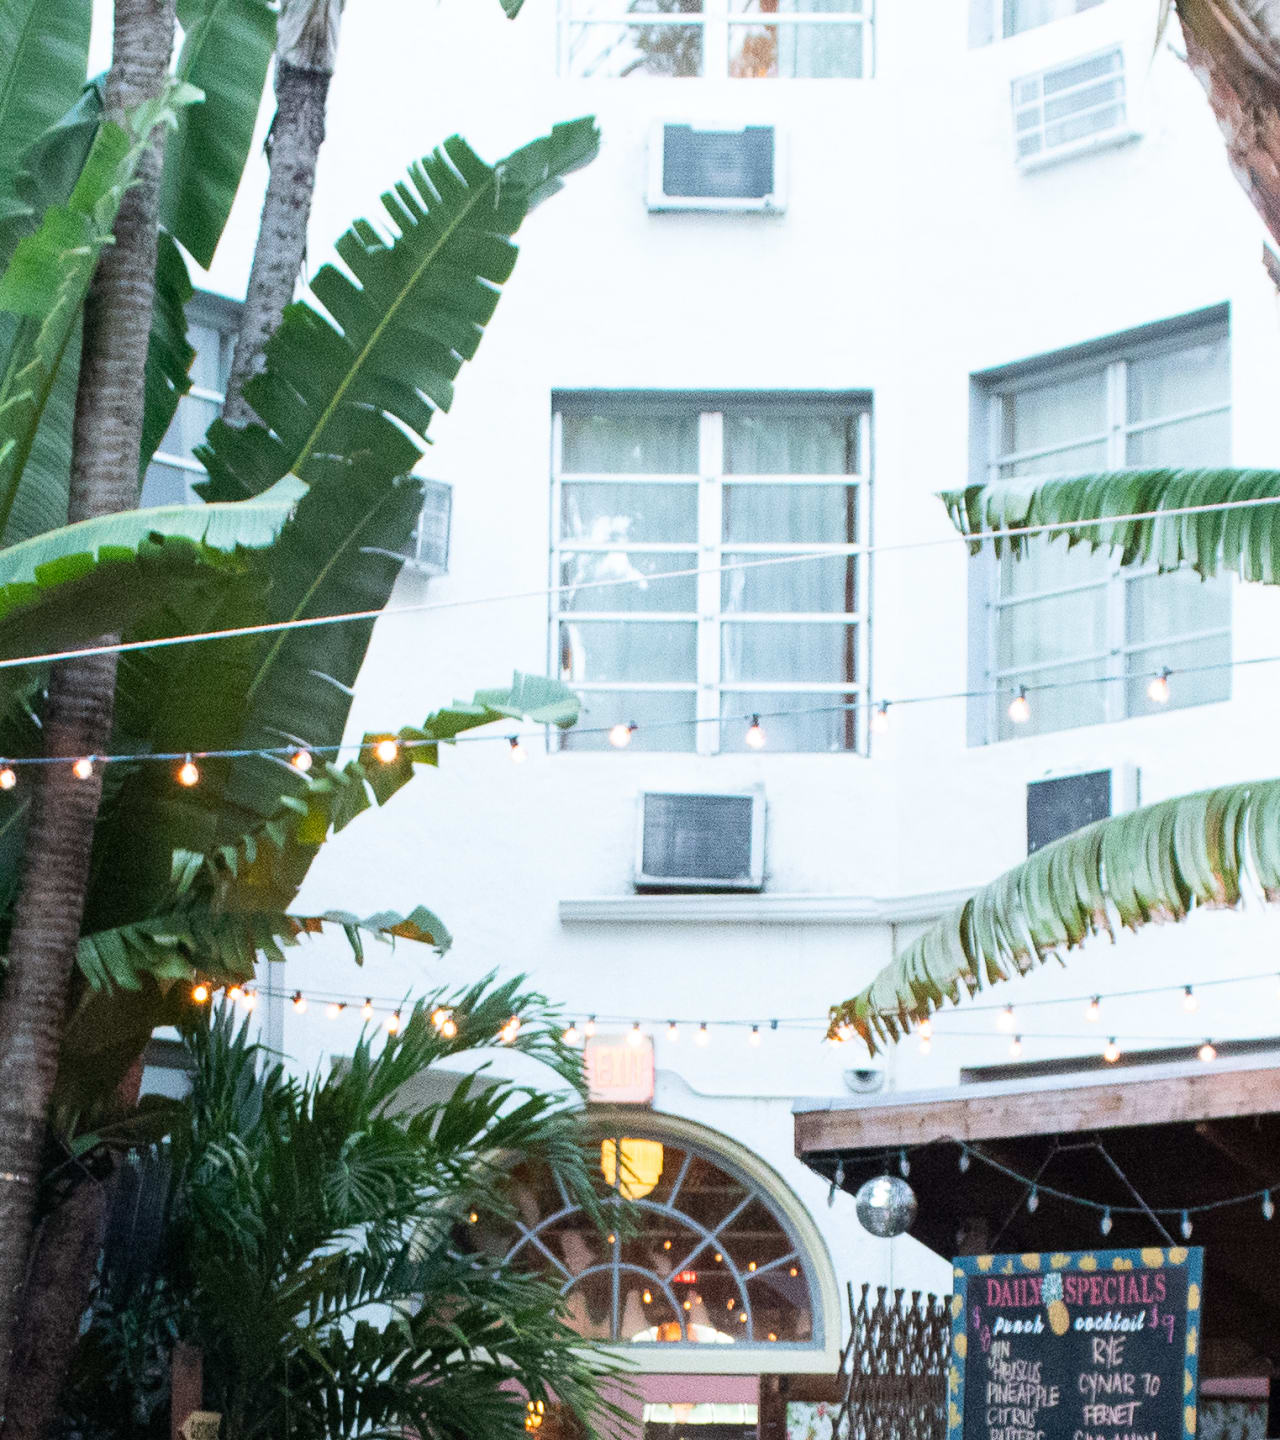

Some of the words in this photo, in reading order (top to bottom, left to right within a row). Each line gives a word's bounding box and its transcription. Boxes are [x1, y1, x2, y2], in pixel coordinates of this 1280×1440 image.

[595, 1047, 646, 1088] EXIT
[986, 1278, 1042, 1307] DAILY
[1064, 1273, 1167, 1306] SPECIALS
[993, 1314, 1045, 1336] punch
[1073, 1310, 1146, 1332] cocktail
[1092, 1335, 1127, 1368] RYE
[986, 1381, 1060, 1408] PINEAPPLE
[1078, 1372, 1135, 1403] CYNAR
[986, 1407, 1039, 1429] CITRUS
